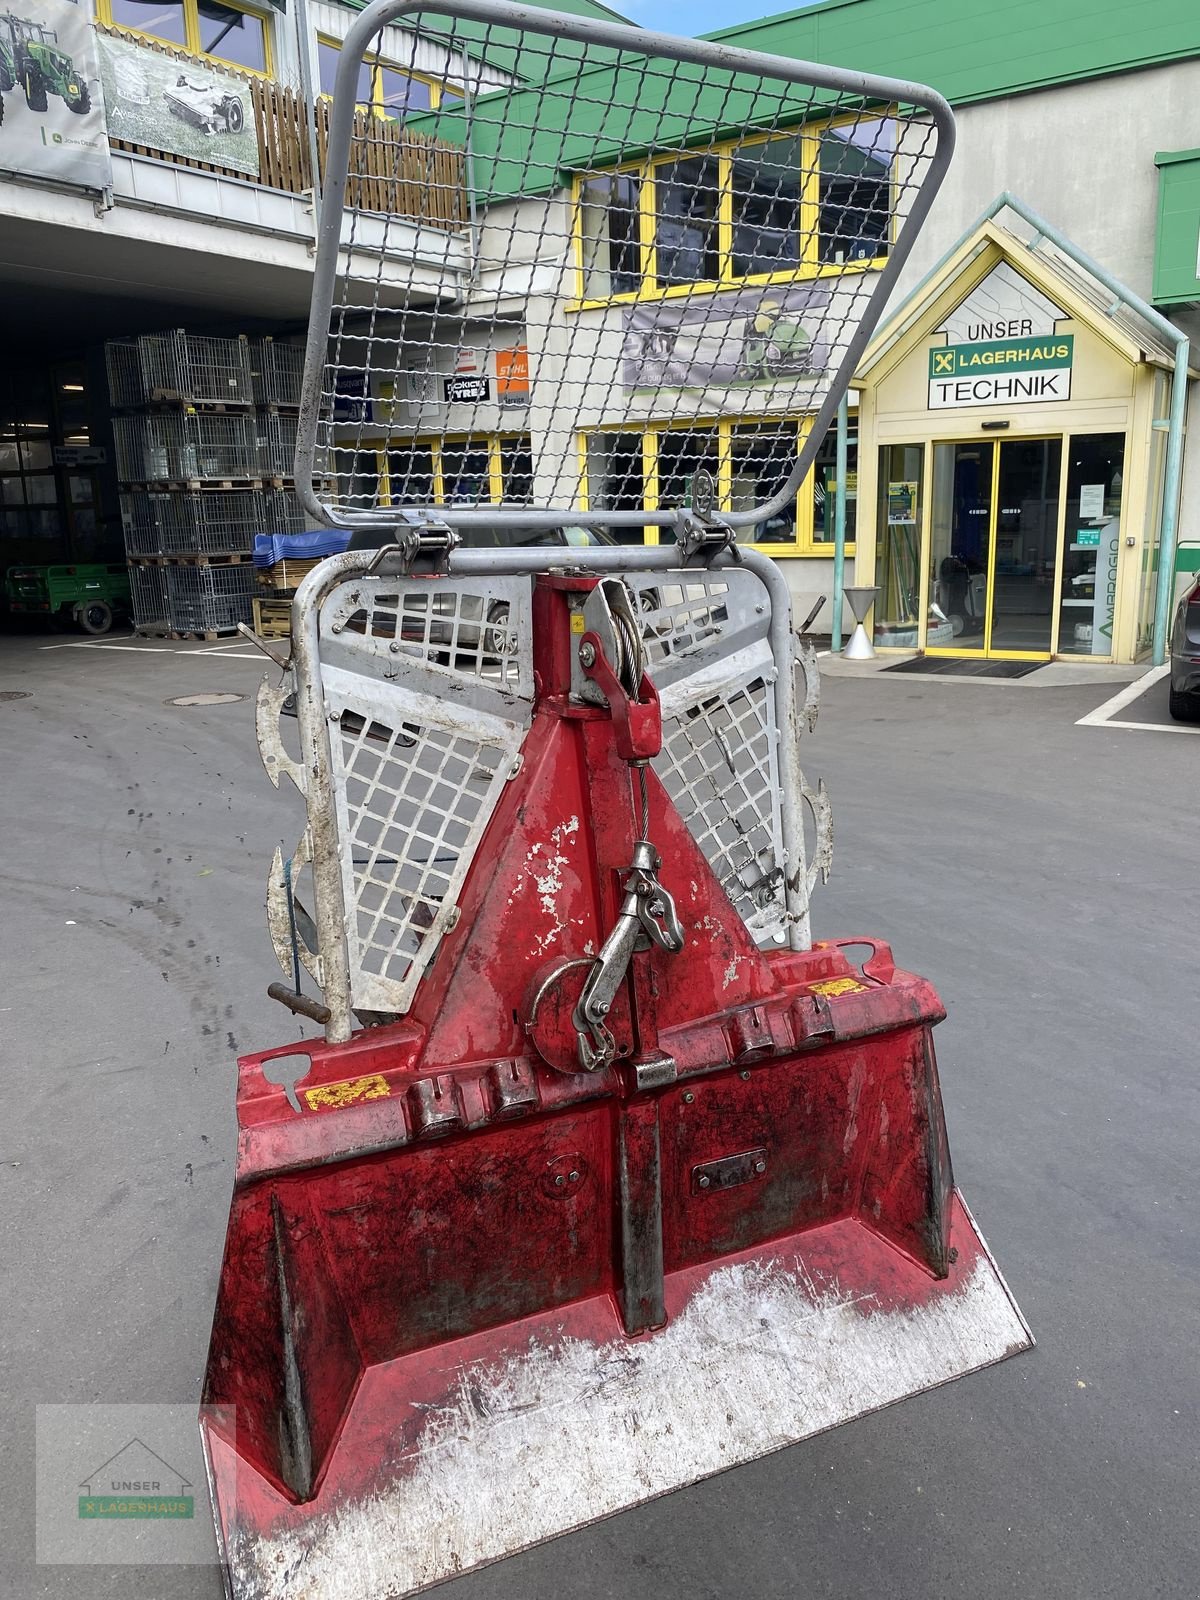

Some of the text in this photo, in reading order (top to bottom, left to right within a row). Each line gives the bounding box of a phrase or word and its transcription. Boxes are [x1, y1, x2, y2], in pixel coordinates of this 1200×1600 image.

[968, 319, 1033, 341] UNSER
[959, 345, 1068, 367] LAGERHAUS
[937, 374, 1060, 402] TECHNIK
